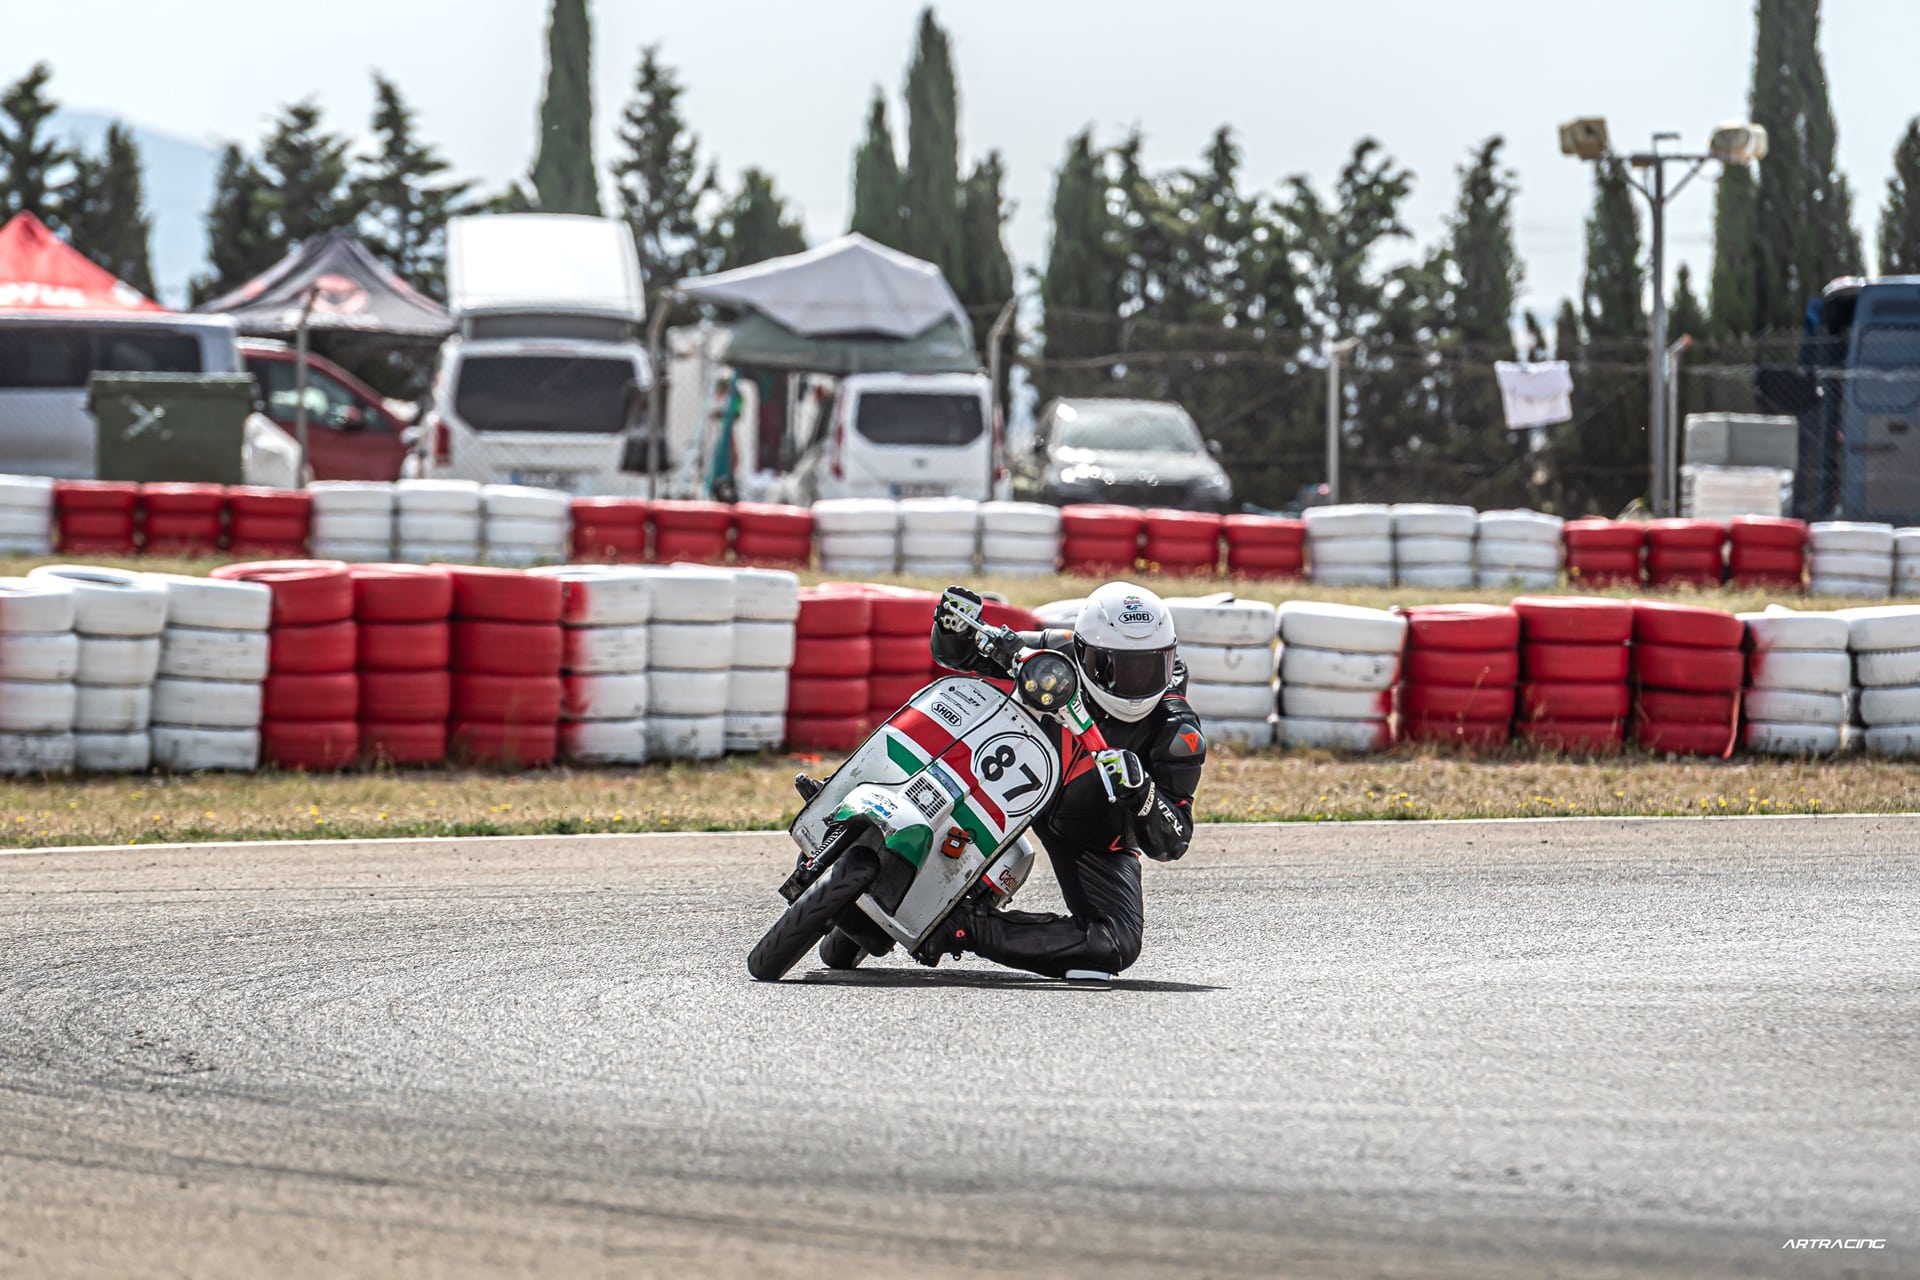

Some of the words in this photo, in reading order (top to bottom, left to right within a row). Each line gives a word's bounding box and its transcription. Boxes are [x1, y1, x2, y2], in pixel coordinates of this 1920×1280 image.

[1123, 612, 1150, 622] SHOEI
[933, 702, 960, 725] SHOEI
[980, 744, 1044, 803] 87
